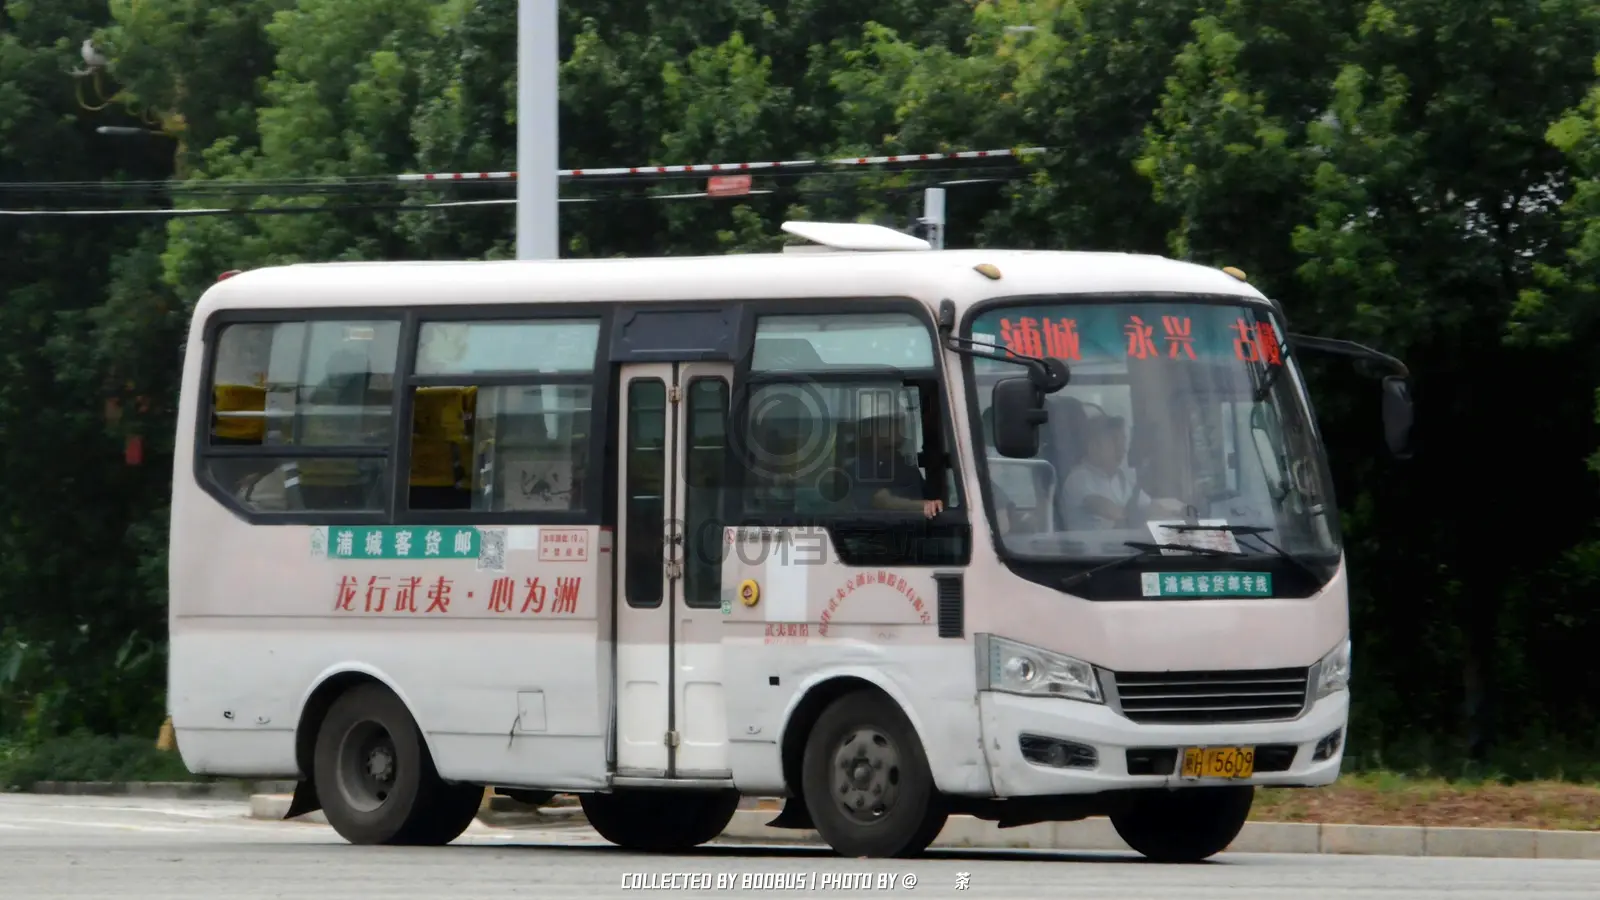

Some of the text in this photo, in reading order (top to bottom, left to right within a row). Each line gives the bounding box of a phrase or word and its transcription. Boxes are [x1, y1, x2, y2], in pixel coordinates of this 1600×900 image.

[1000, 315, 1082, 360] 浦城
[1124, 315, 1197, 360] 永兴
[336, 529, 473, 556] 浦城客货邮
[1165, 575, 1268, 592] 浦城客货邮专线
